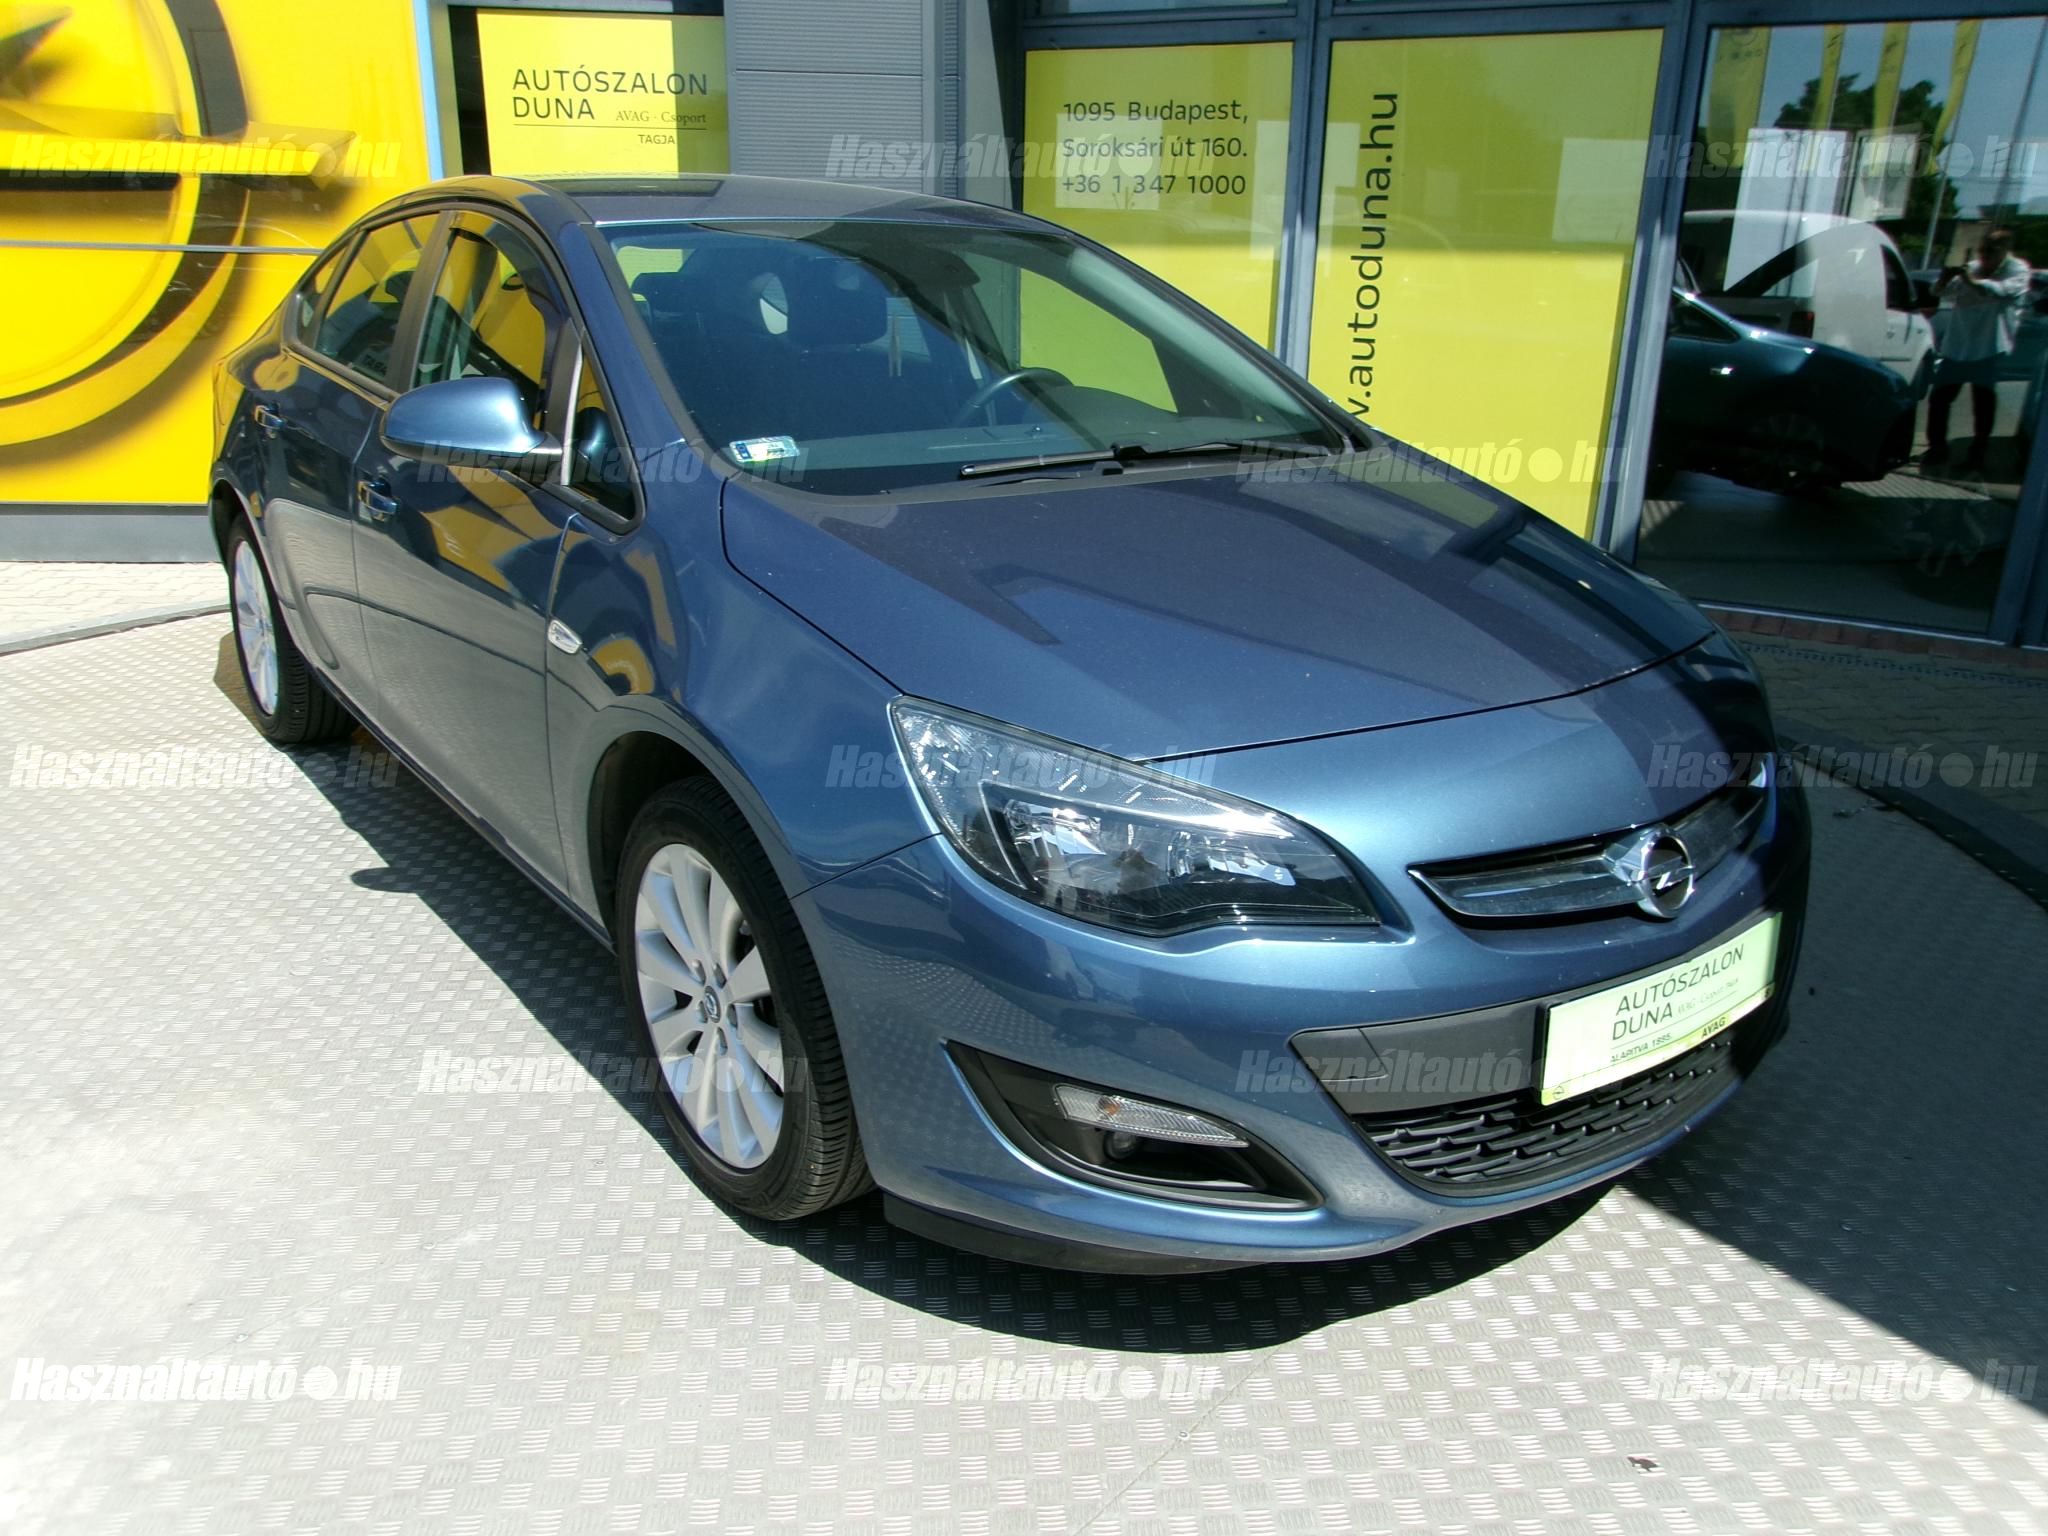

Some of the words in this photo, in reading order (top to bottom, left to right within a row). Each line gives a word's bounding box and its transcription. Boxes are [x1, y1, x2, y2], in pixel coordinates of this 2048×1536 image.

[512, 64, 707, 96] AUTÓSZALON
[512, 96, 595, 120] DUNA
[615, 110, 650, 123] AVAG
[660, 111, 707, 126] Csoport
[1063, 101, 1116, 122] 1095
[1127, 99, 1249, 125] Budapest,
[637, 133, 676, 146] TAGJA
[1063, 136, 1164, 158] Soroksári
[1170, 136, 1196, 158] út
[1202, 137, 1248, 158] 160.
[1062, 174, 1101, 194] +36
[1112, 174, 1122, 193] 1
[1187, 174, 1247, 195] 1000
[1615, 943, 1745, 1017] AUTÓSZALON
[1611, 1001, 1673, 1041] DUNA
